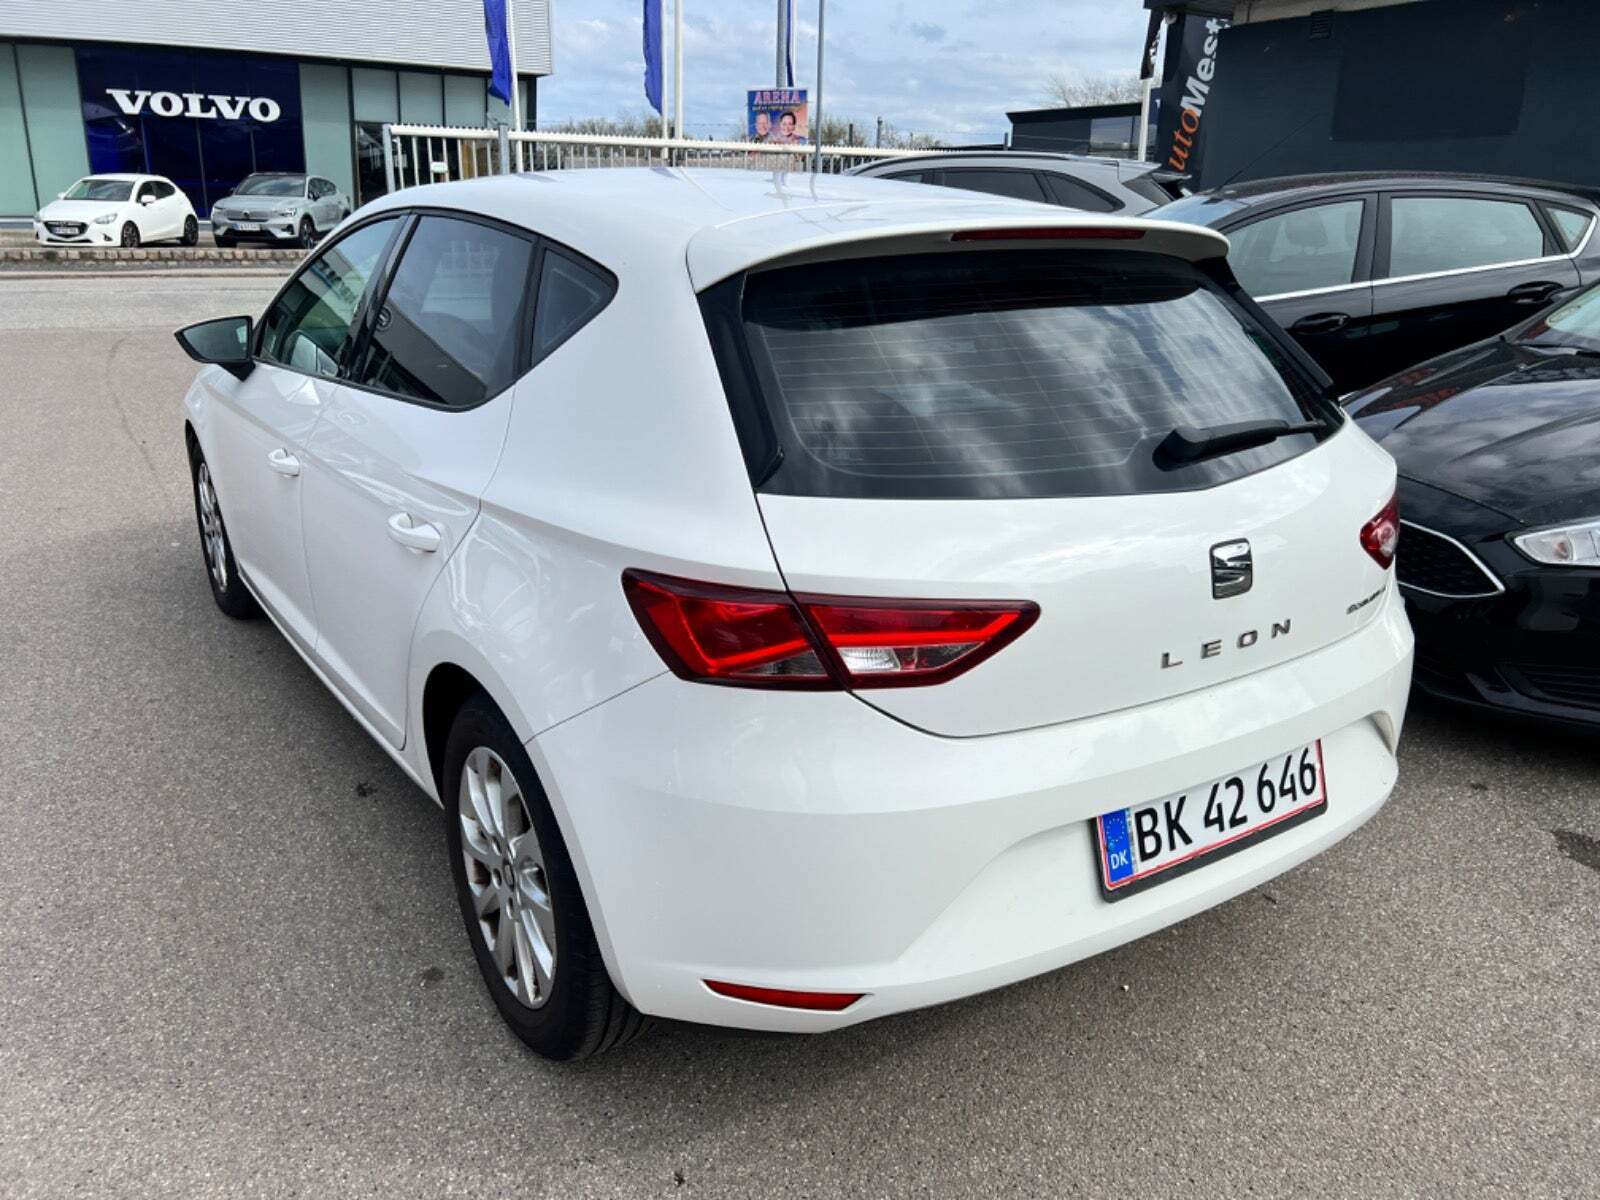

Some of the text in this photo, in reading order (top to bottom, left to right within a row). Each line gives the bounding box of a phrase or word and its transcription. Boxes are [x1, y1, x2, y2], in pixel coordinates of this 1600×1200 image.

[106, 88, 281, 122] VOLVO
[1168, 18, 1232, 172] utoMest
[1161, 619, 1292, 669] LEON
[1134, 747, 1317, 862] BK 42 646
[1110, 850, 1129, 870] DK
